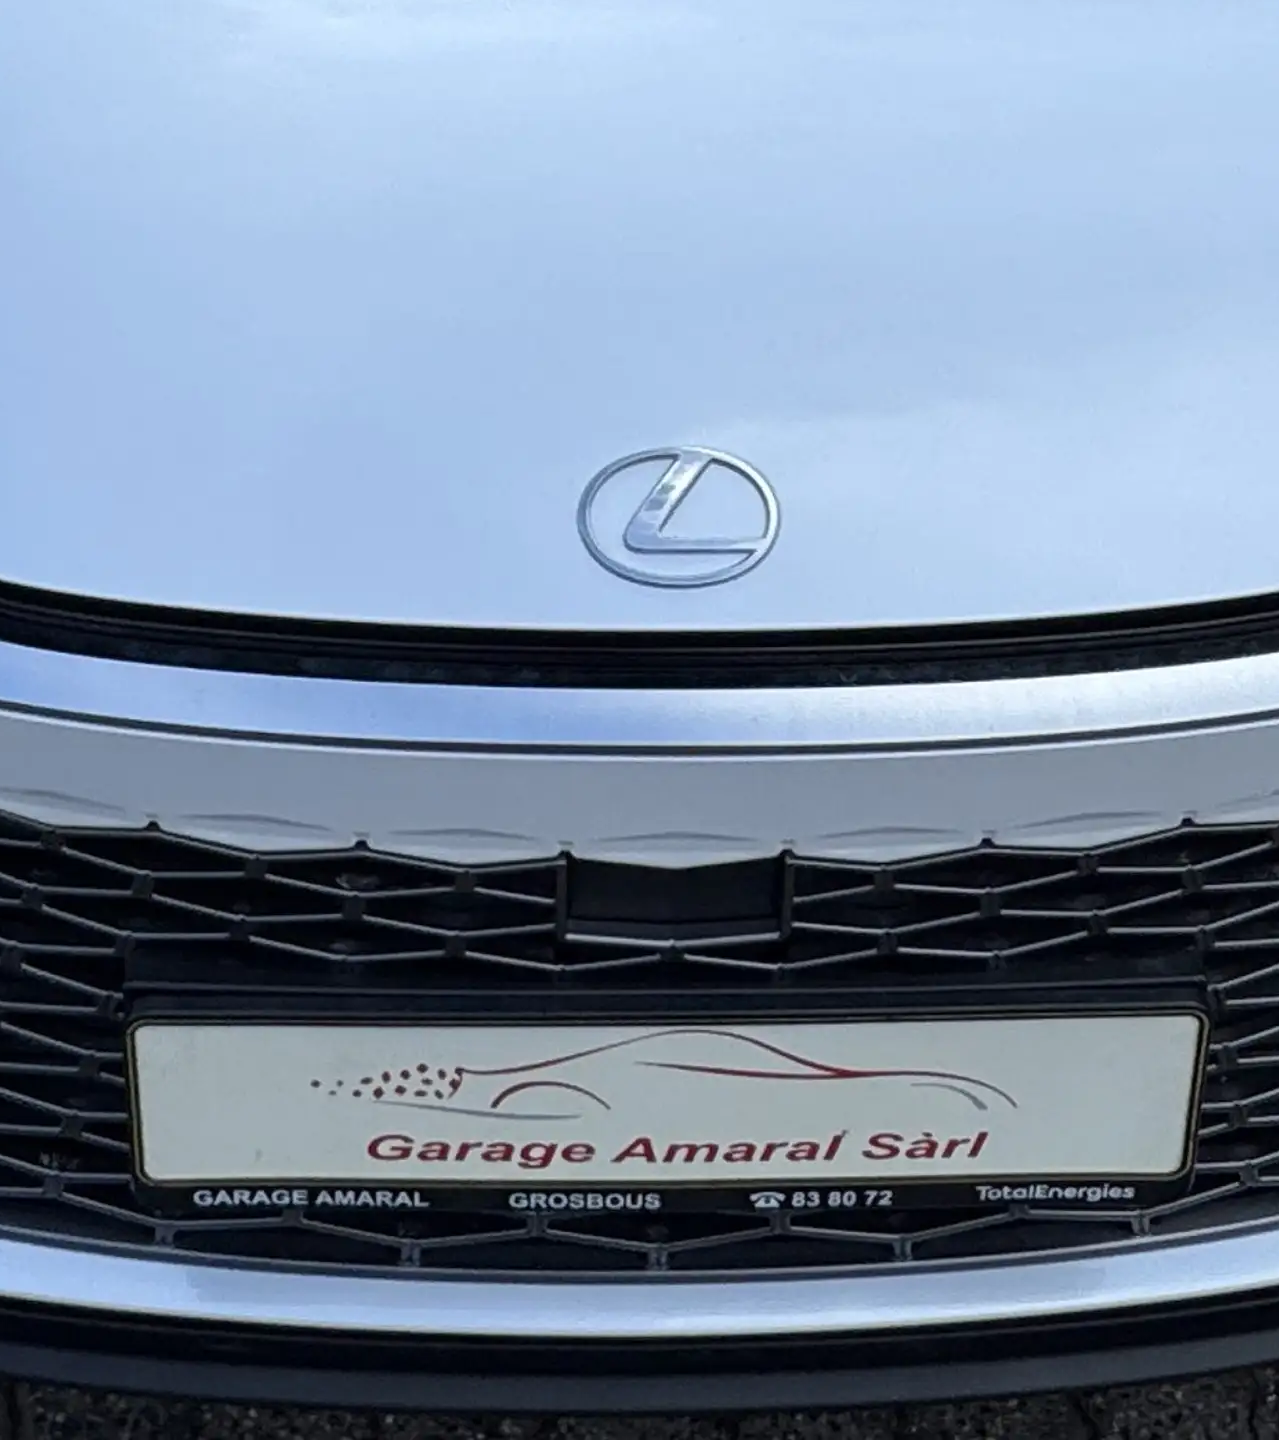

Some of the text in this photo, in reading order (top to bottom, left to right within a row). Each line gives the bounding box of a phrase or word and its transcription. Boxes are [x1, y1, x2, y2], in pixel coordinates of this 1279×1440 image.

[367, 1131, 989, 1169] Garage Amaral Sàrl
[193, 1184, 1136, 1210] GARAGE AMARAL GROSBOUS 83 80 72 TotalEnergies
